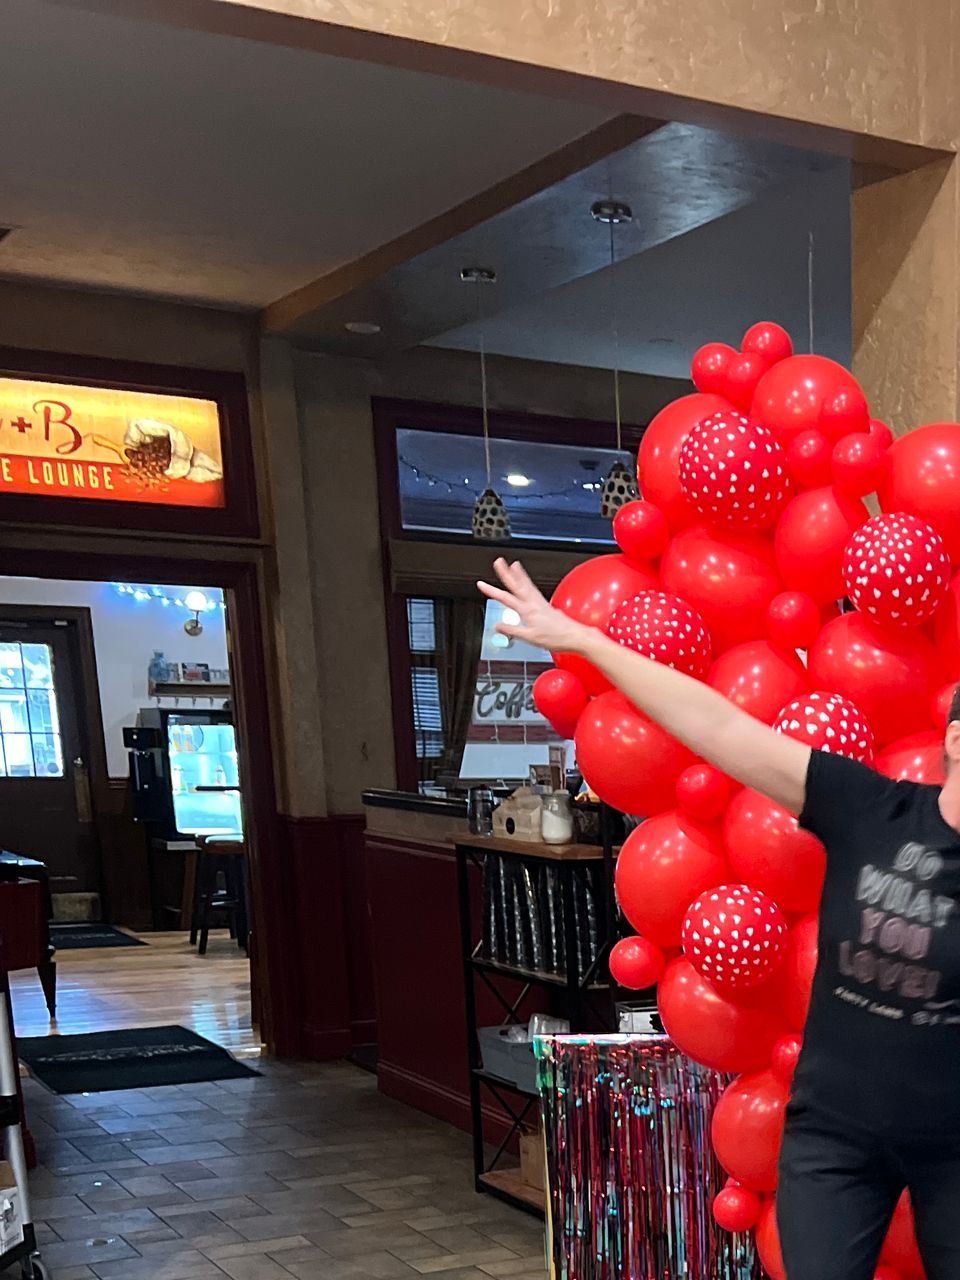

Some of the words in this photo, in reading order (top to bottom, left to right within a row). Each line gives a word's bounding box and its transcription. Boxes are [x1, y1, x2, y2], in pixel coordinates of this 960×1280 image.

[27, 460, 115, 490] LOUNGE
[475, 681, 541, 718] Coffe
[856, 863, 955, 928] WHAT
[860, 907, 931, 960] YOU
